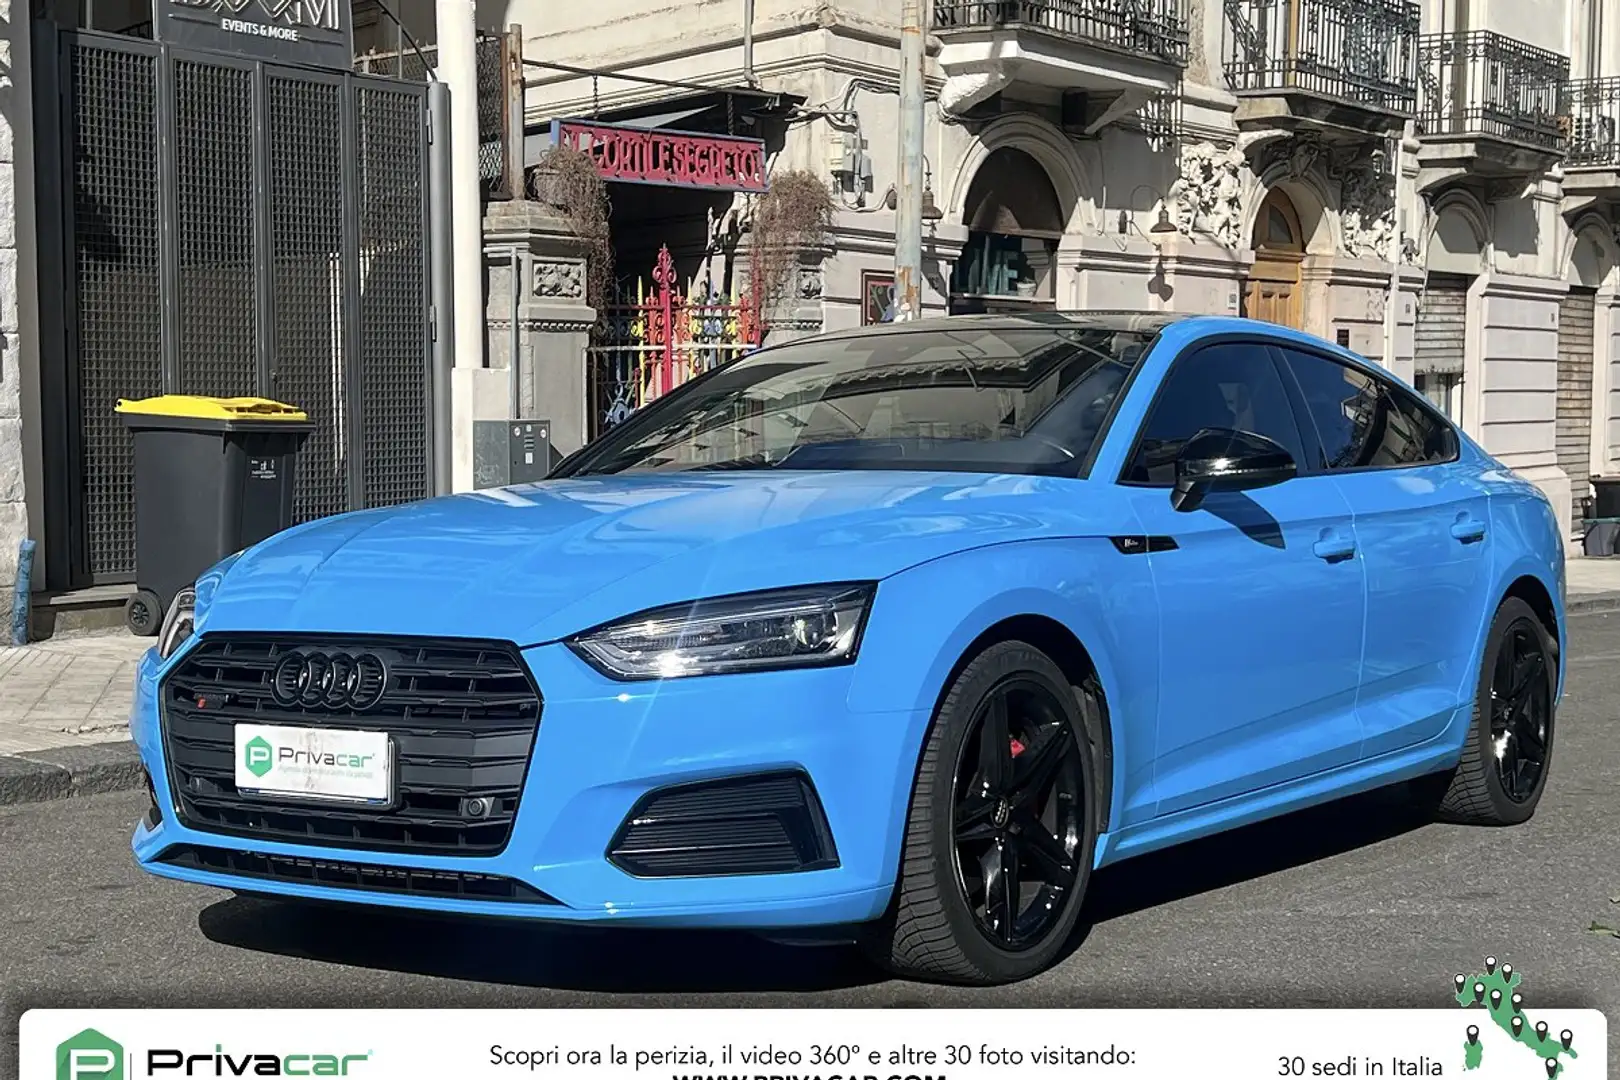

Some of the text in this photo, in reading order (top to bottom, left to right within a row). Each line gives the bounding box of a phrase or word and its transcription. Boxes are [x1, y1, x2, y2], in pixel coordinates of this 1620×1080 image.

[221, 18, 299, 42] EVENTS & MORE
[278, 746, 373, 768] Privacar
